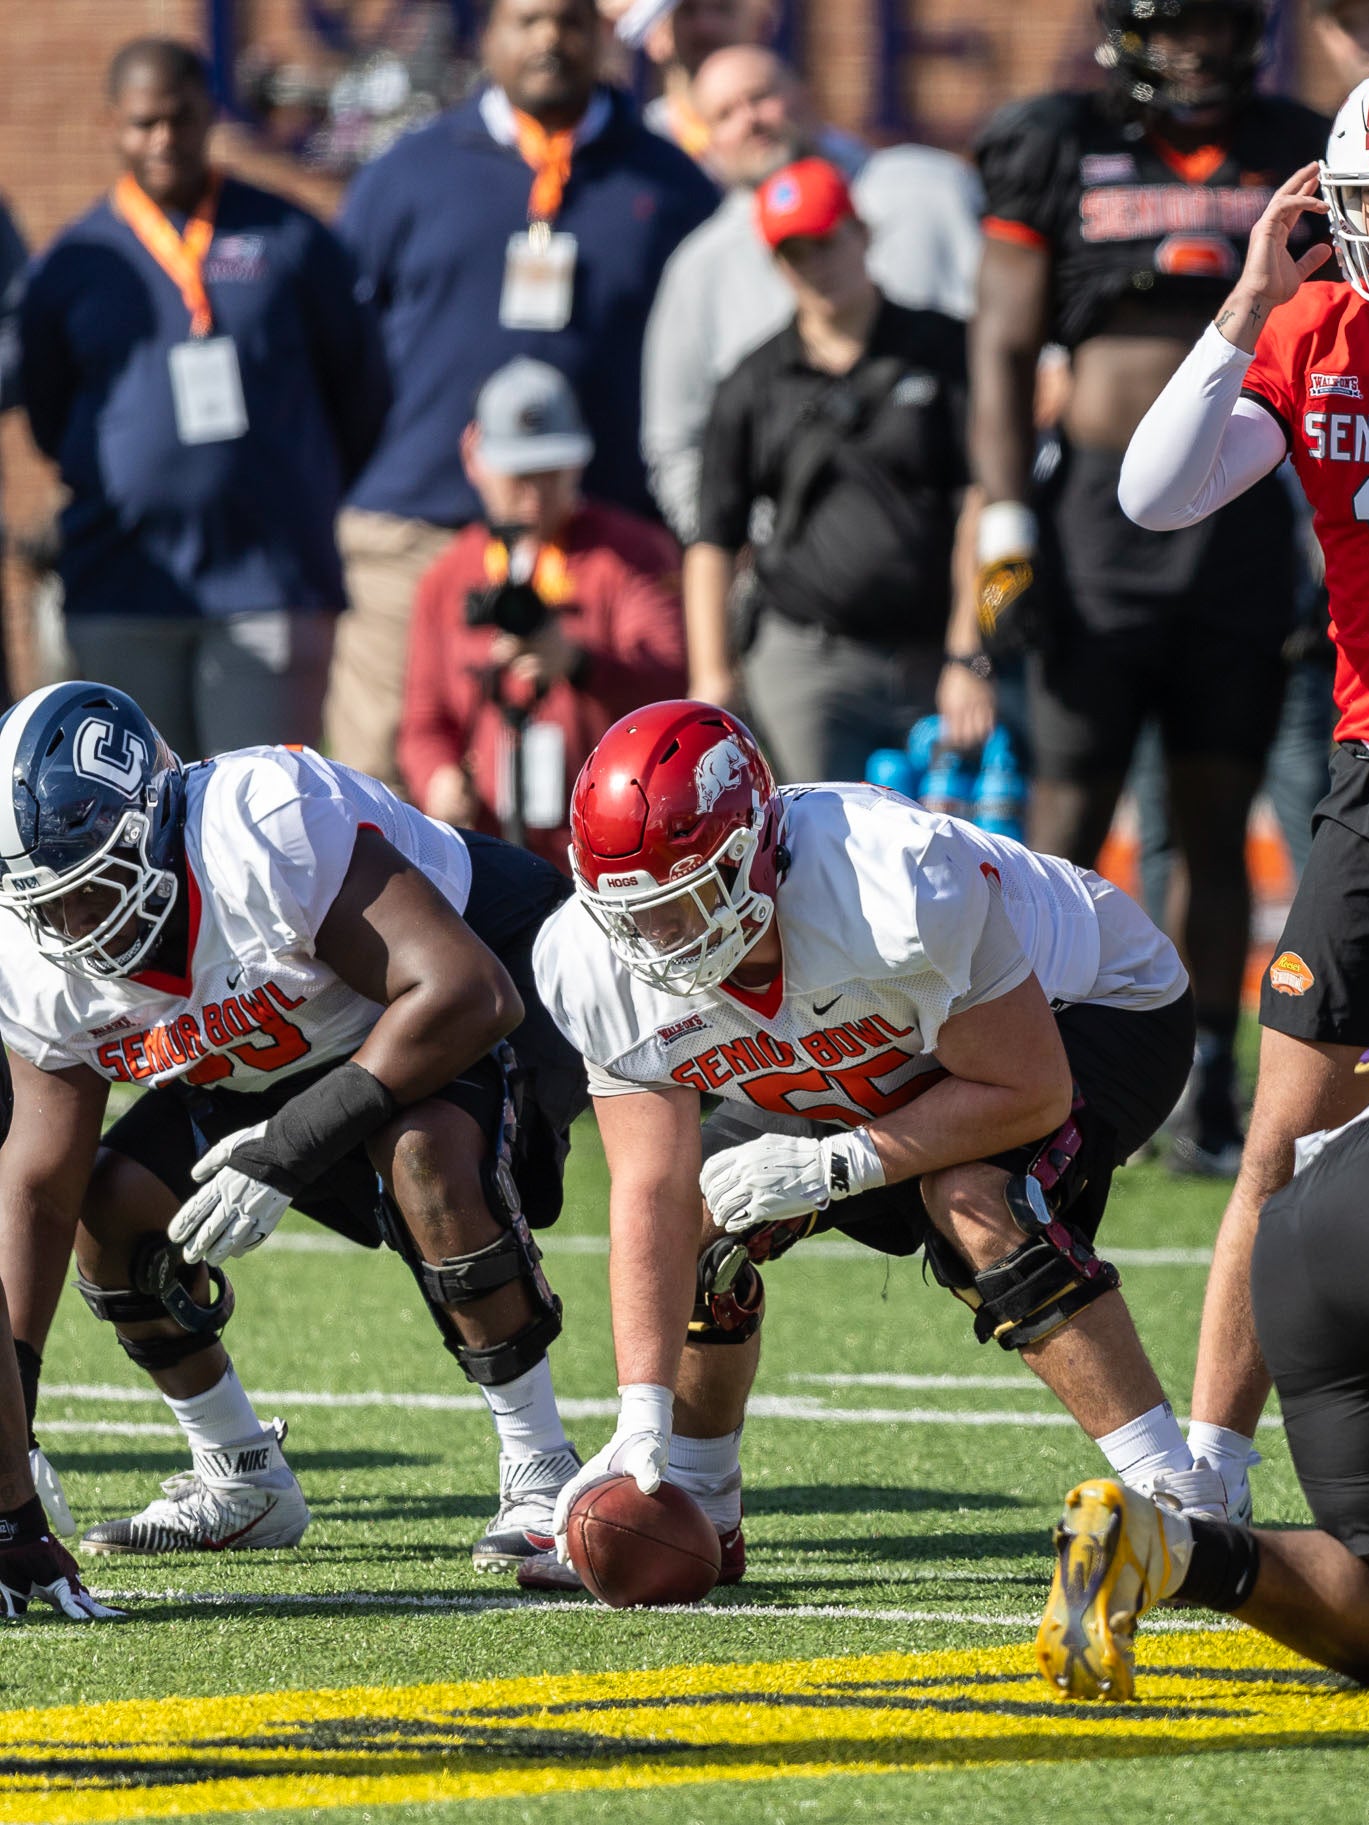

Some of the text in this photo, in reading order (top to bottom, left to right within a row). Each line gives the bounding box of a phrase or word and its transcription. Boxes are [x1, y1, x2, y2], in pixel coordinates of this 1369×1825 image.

[73, 716, 149, 800] C
[606, 876, 639, 888] HOGS
[97, 1013, 209, 1082] SENIOR
[202, 980, 308, 1047] BOWL
[670, 1013, 916, 1091] SENIO BOWL
[234, 1447, 269, 1474] NIKE
